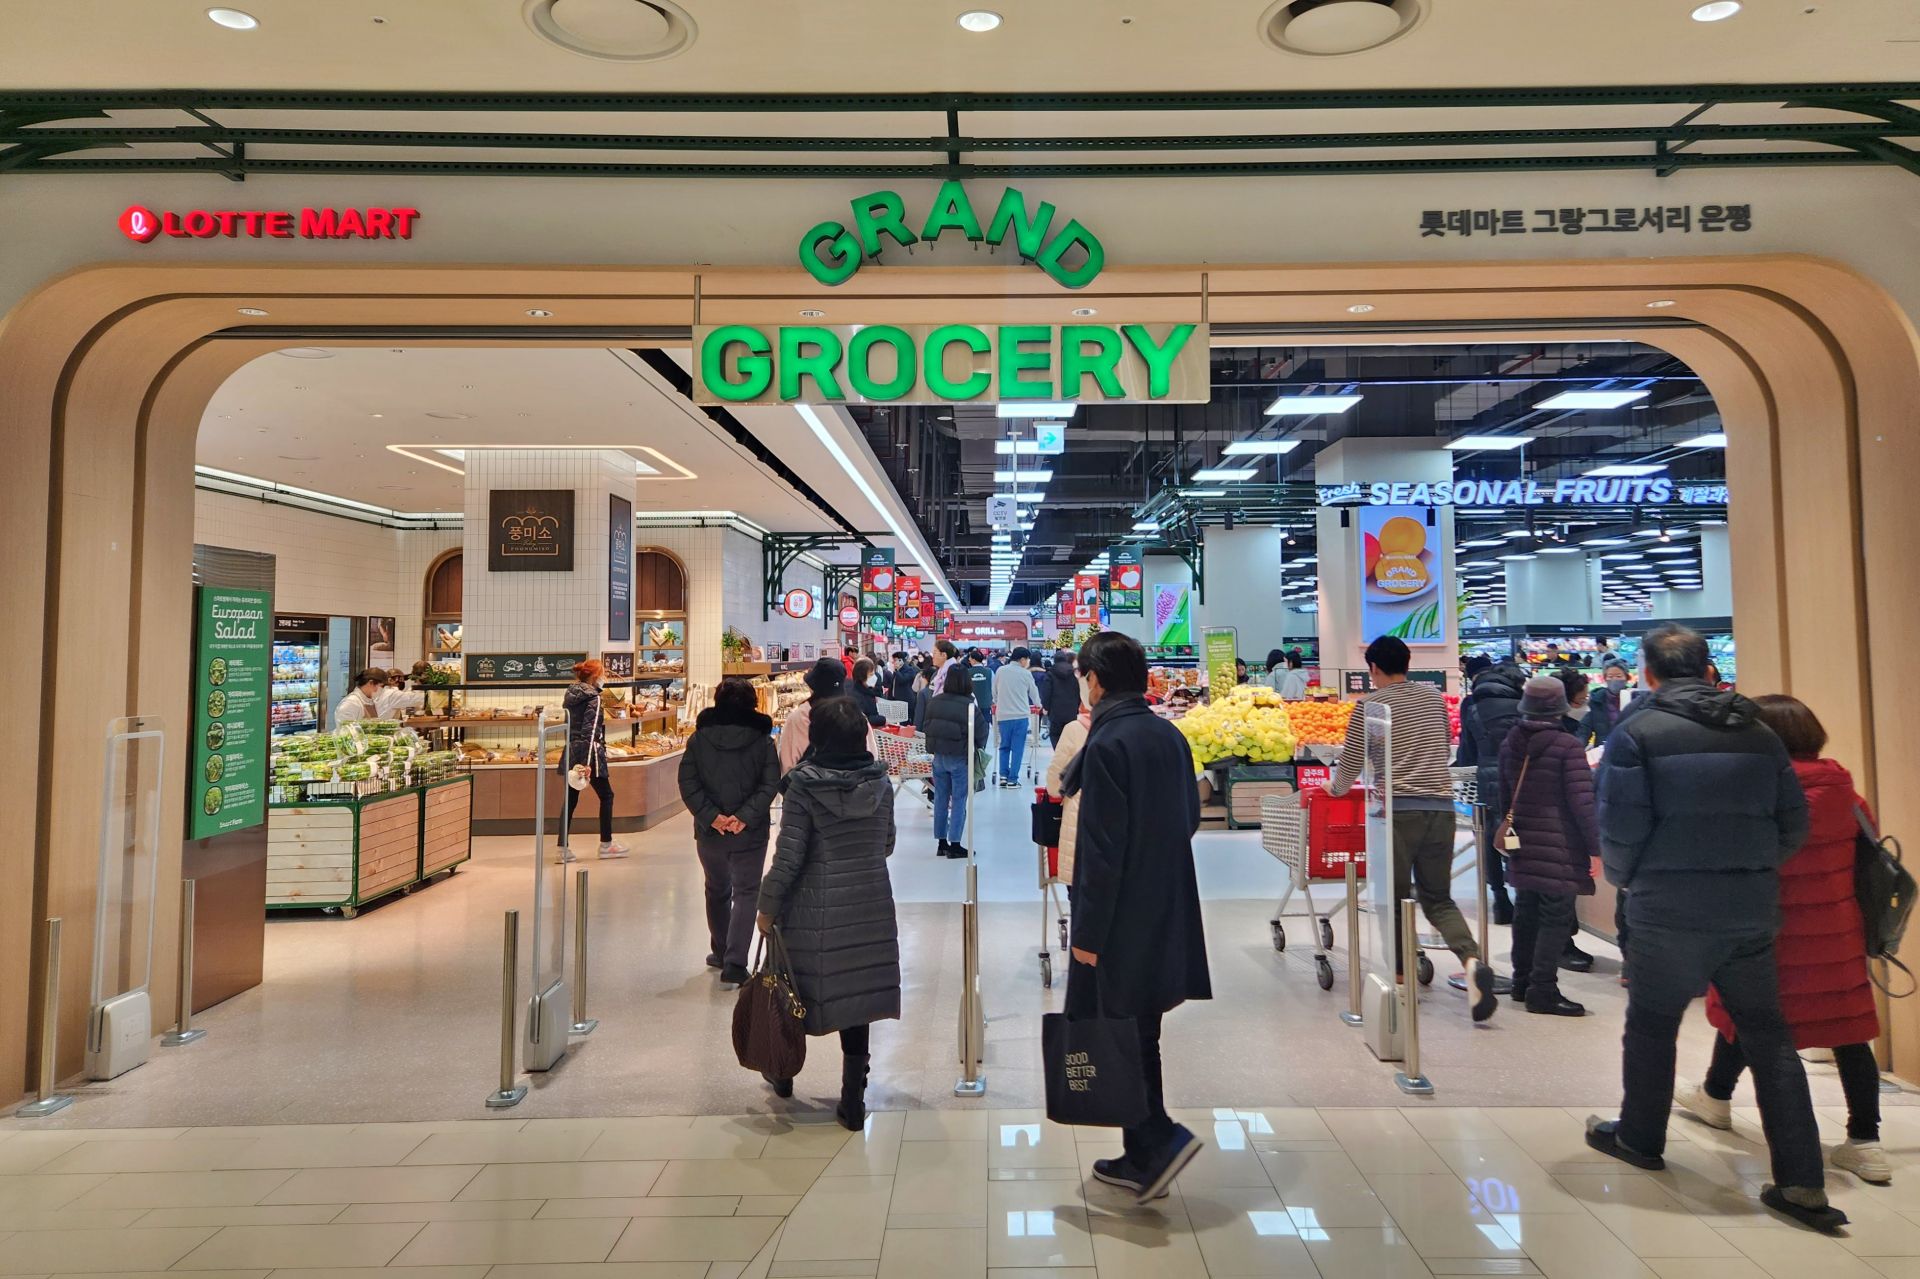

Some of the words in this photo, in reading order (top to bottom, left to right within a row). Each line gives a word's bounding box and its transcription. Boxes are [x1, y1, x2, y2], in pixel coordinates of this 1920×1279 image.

[163, 210, 296, 238] LOTTE
[300, 207, 420, 240] MART
[1420, 209, 1526, 237] 롯데마트
[1532, 205, 1691, 235] 그랑그로서리
[1698, 204, 1752, 232] 은평
[799, 180, 1105, 290] GRAND
[701, 325, 1197, 401] GROCERY
[1318, 480, 1361, 503] Fresh
[1369, 479, 1545, 506] SEASONAL
[1552, 477, 1672, 504] FRUITS
[508, 526, 552, 541] 풍미소
[211, 604, 264, 623] European
[214, 621, 257, 639] Salad
[1065, 1052, 1088, 1065] GOOD
[1065, 1065, 1097, 1078] BETTER
